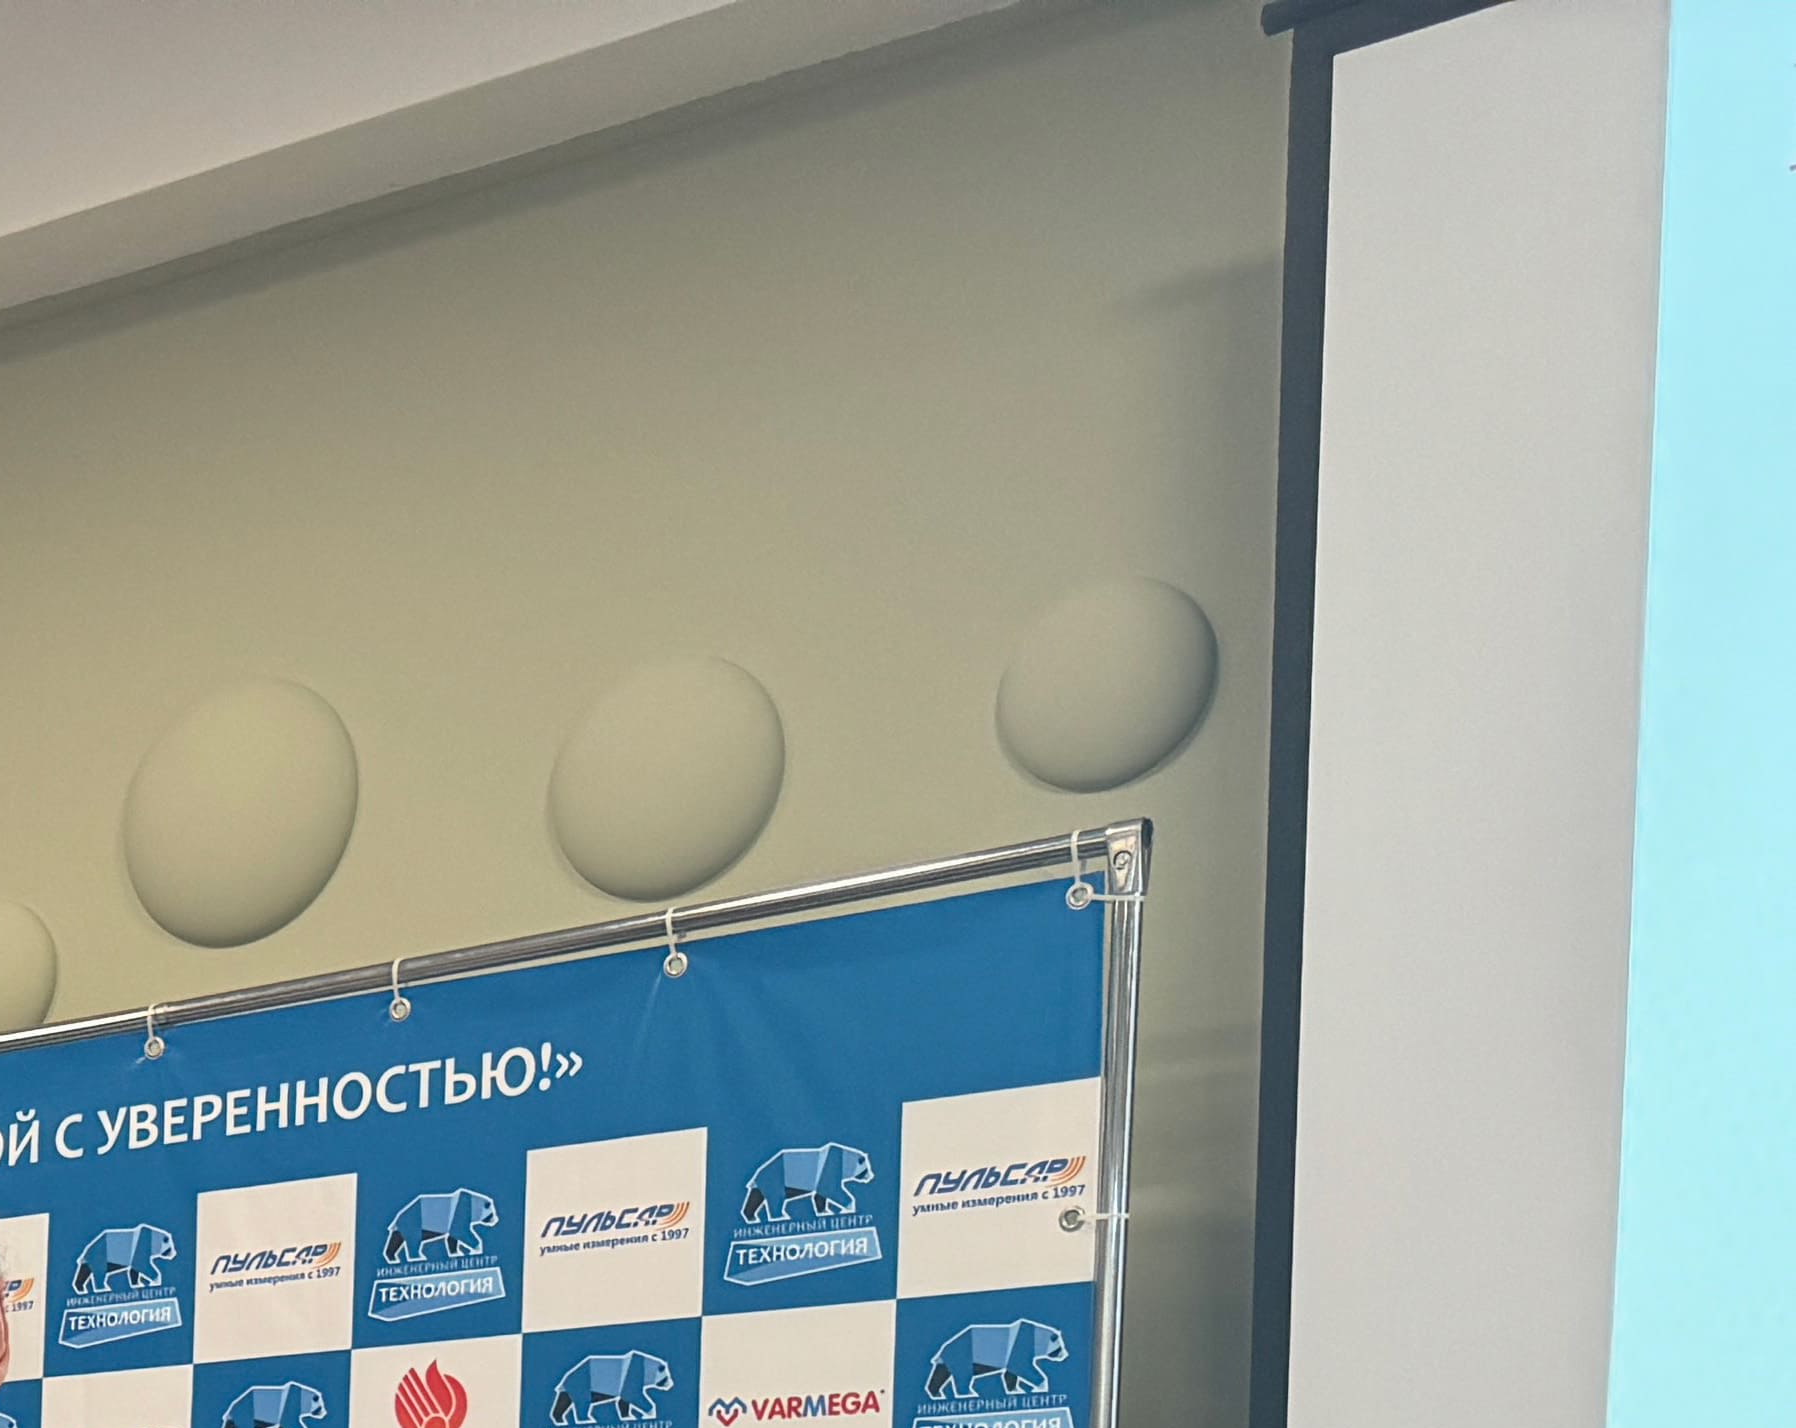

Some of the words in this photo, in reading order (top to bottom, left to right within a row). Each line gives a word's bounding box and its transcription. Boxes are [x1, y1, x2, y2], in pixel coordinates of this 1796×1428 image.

[55, 1113, 84, 1159] С
[96, 1041, 583, 1155] УВЕРЕННОСТЬЮ!»
[913, 1158, 1069, 1197] ПУЛЬСАР
[912, 1201, 958, 1216] умные
[1041, 1191, 1048, 1200] с
[1053, 1184, 1085, 1199] 1997
[541, 1204, 675, 1238] ПУЛЬСАР
[661, 1228, 689, 1241] 1997
[830, 1214, 873, 1229] ЦЕНТР
[211, 1244, 327, 1275] ПУЛЬСАР
[736, 1237, 868, 1265] ТЕХНОЛОГИЯ
[316, 1266, 340, 1279] 1997
[379, 1276, 494, 1303] ТЕХНОЛОГИЯ
[68, 1306, 172, 1331] ТЕХНОЛОГИЯ
[751, 1391, 880, 1420] VARMEGA
[1021, 1394, 1067, 1408] ЦЕНТР
